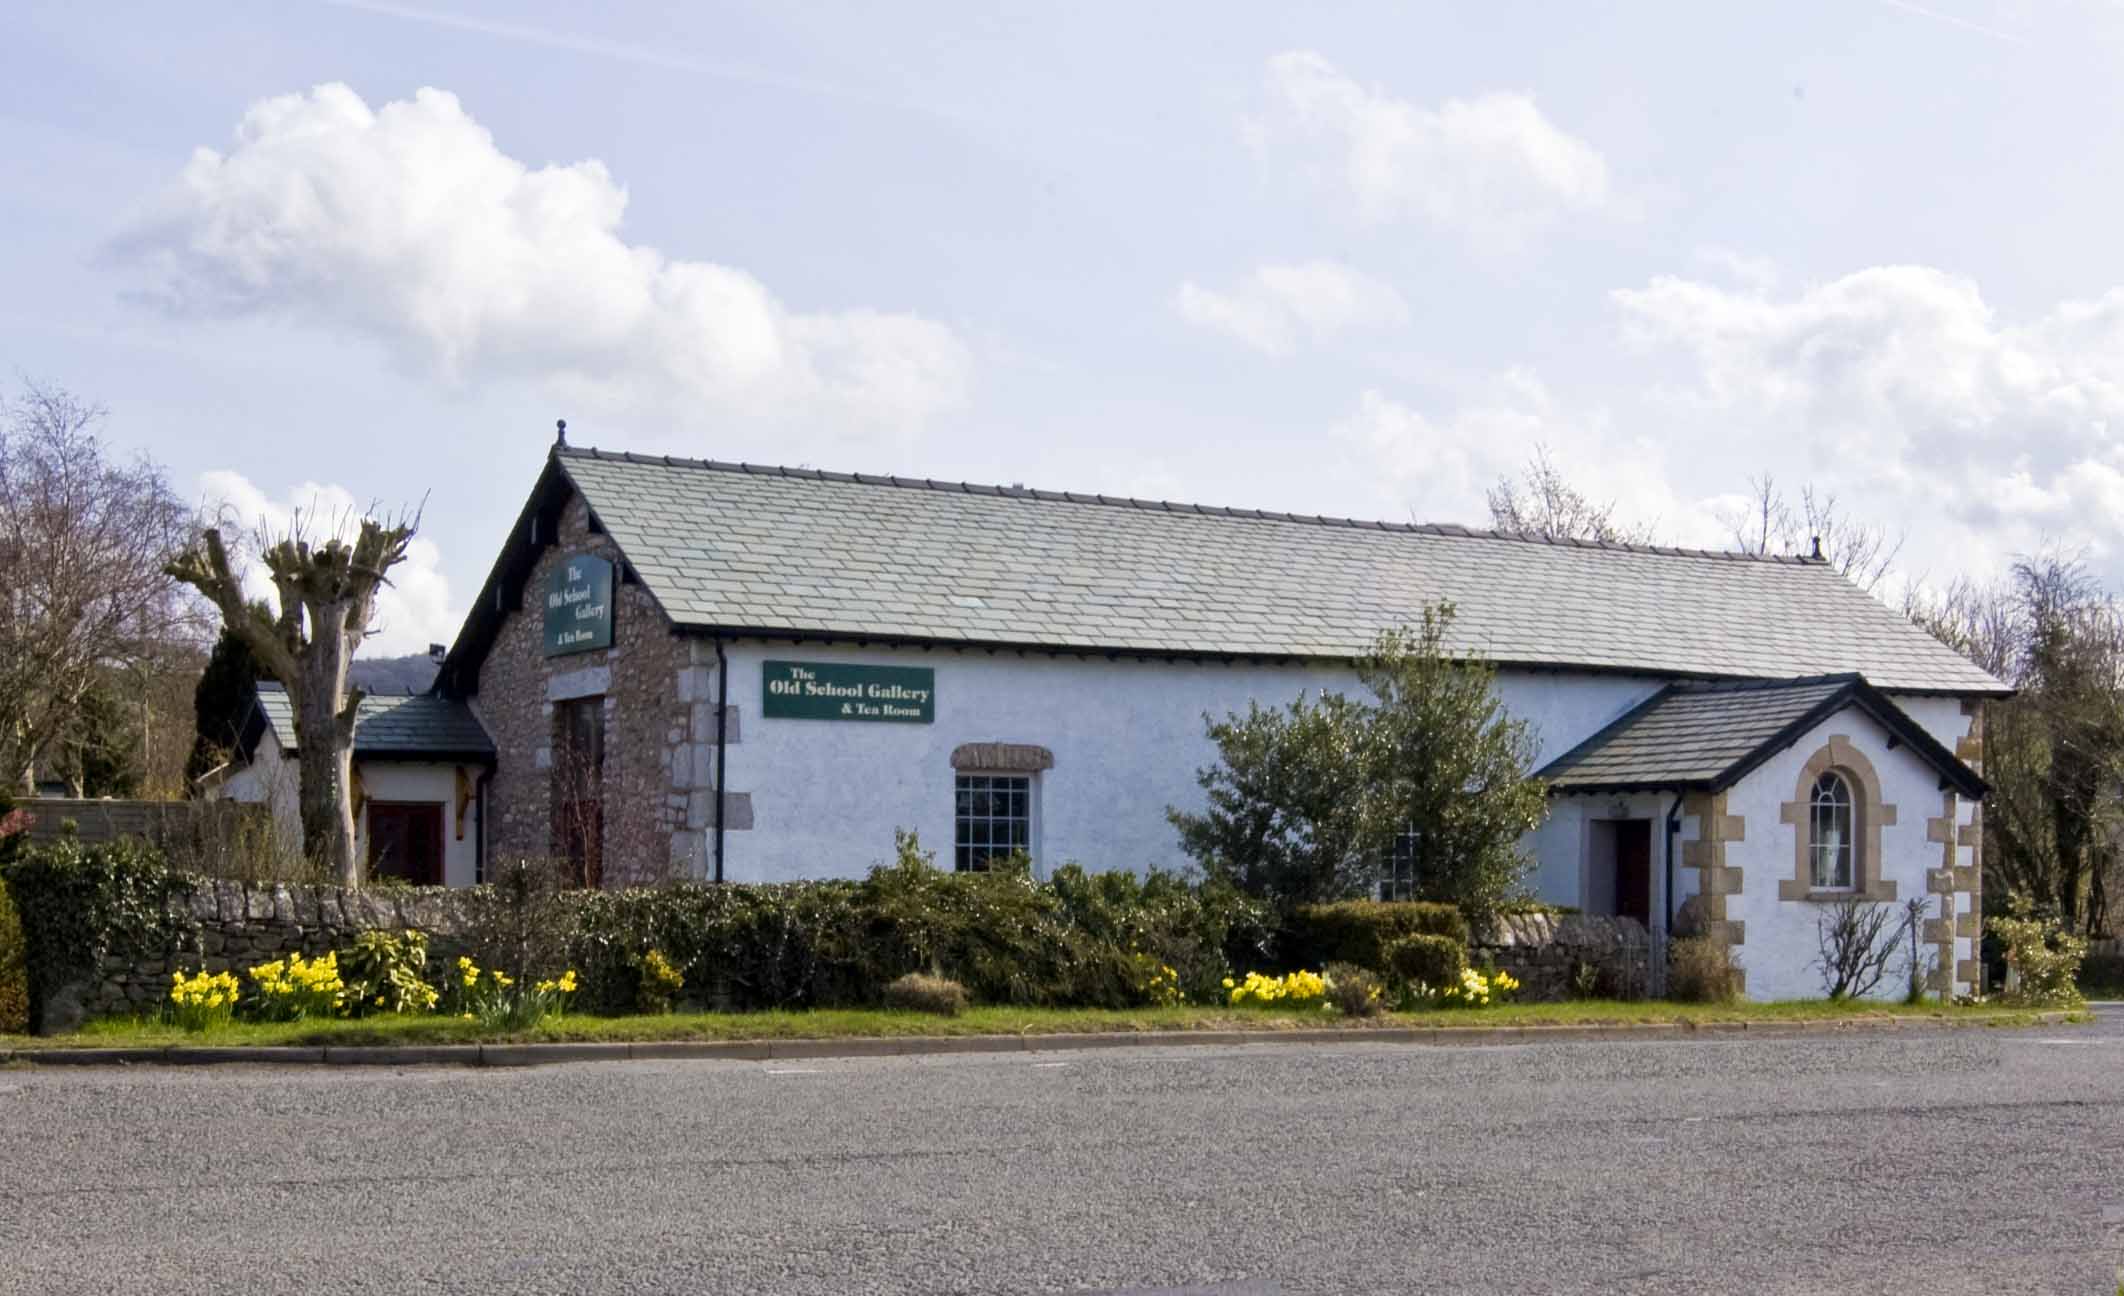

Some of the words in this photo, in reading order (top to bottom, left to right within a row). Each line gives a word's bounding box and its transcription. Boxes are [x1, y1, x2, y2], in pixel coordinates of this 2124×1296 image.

[568, 567, 583, 582] The
[790, 667, 816, 680] The
[769, 679, 801, 695] Old
[805, 681, 863, 698] School
[867, 683, 929, 703] Gallery
[841, 702, 852, 715] &
[855, 703, 880, 716] Tea
[883, 704, 921, 717] Room
